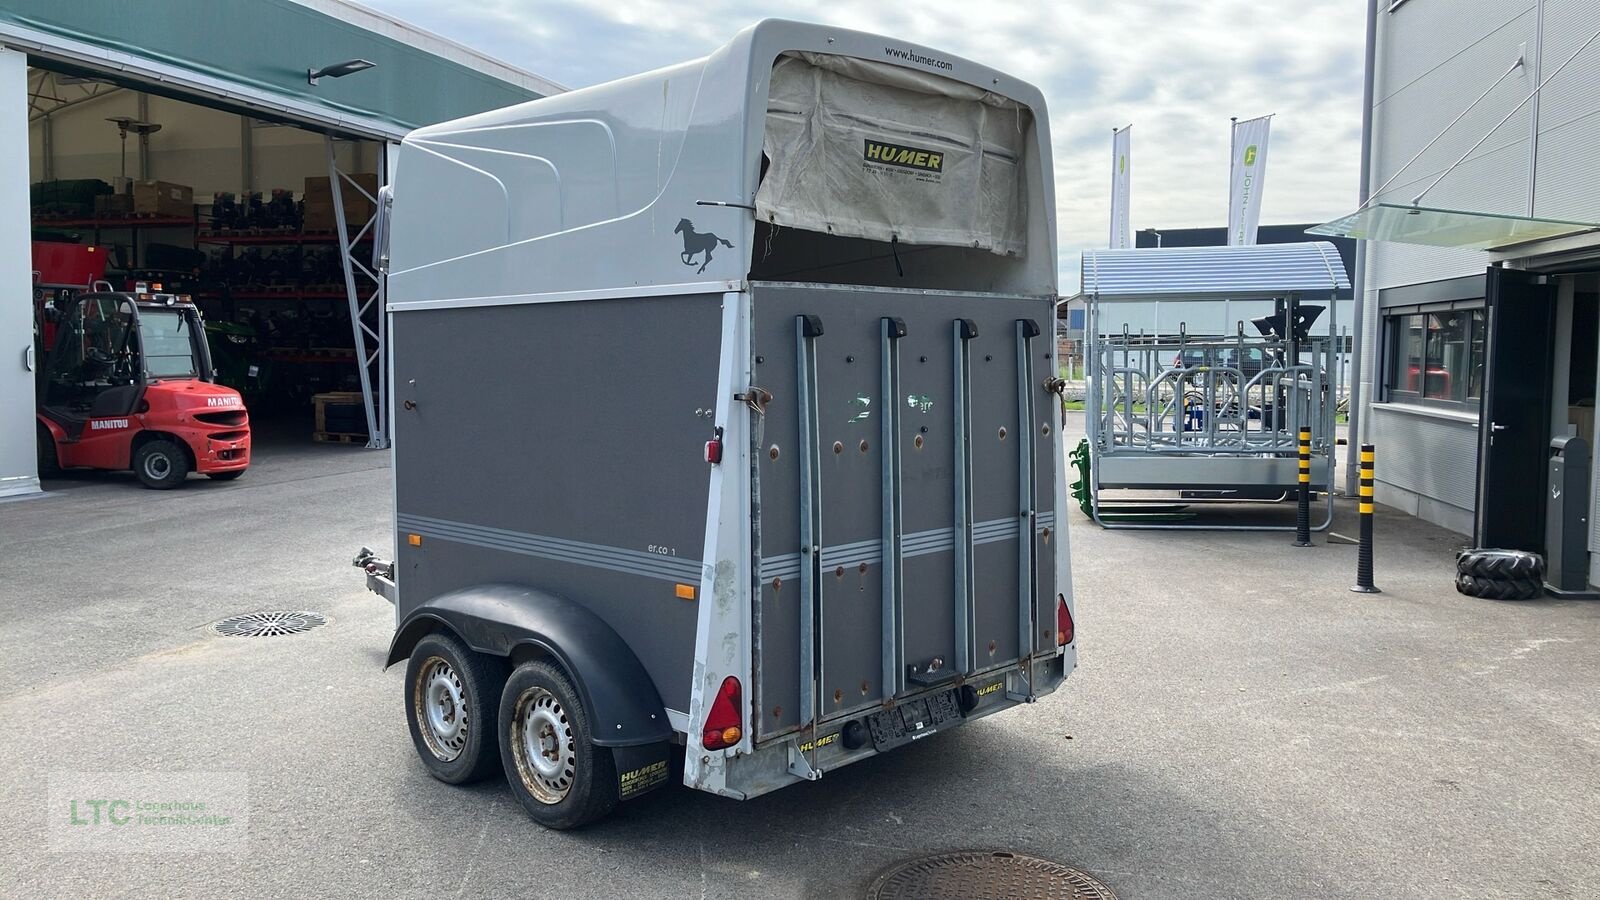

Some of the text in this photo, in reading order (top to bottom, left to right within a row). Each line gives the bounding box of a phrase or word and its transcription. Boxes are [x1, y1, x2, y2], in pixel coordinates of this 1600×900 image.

[885, 47, 953, 71] www.humer.com
[867, 143, 943, 169] HUMER
[1242, 171, 1252, 205] JOHN
[91, 419, 129, 430] MANITOU
[621, 761, 667, 782] HUMER
